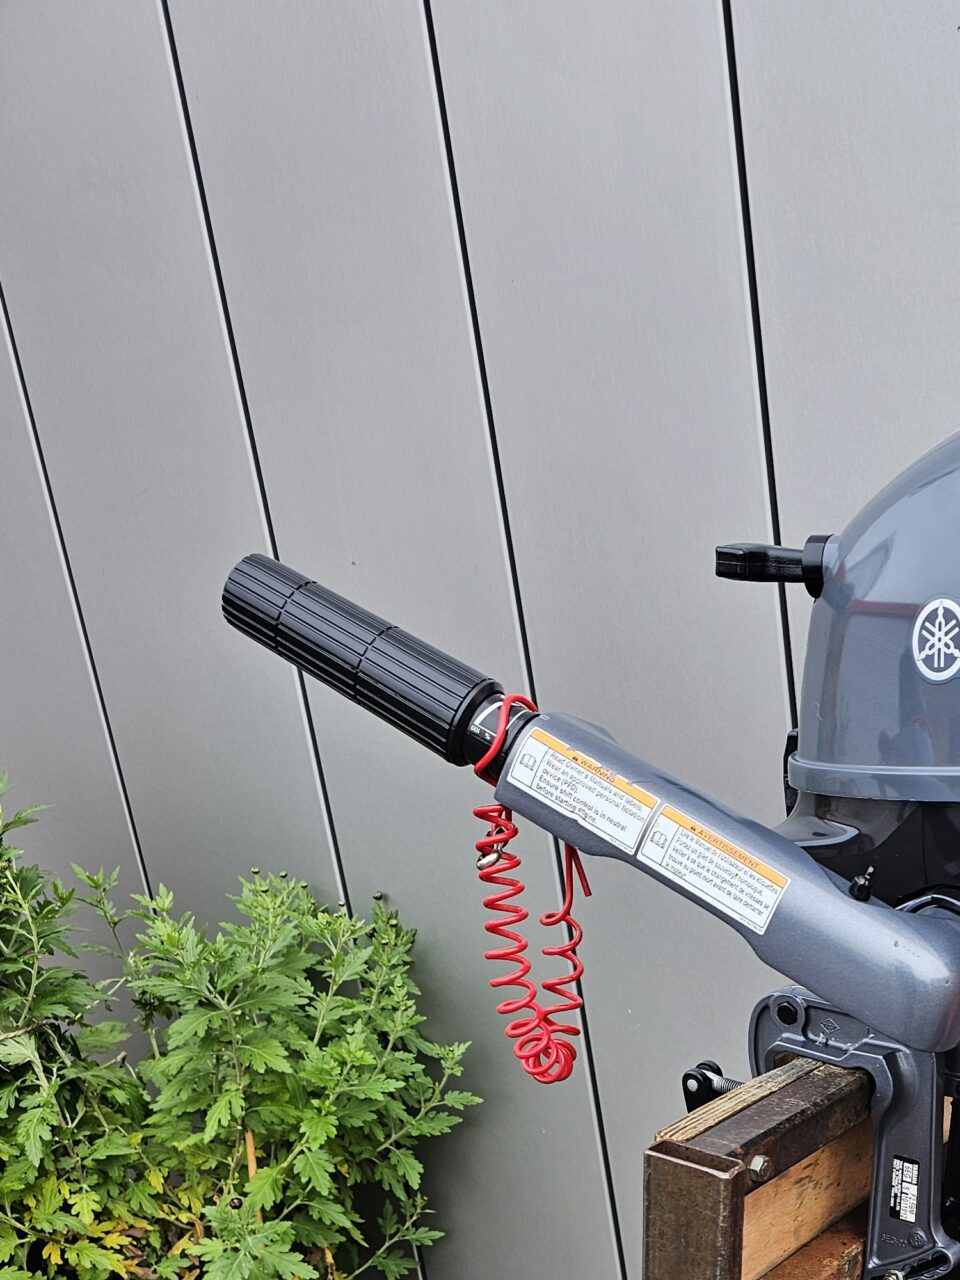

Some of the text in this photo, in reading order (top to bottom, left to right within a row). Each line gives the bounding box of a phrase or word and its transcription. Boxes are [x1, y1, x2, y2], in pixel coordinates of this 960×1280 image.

[541, 766, 562, 782] device
[545, 758, 562, 772] Wear
[560, 769, 569, 777] an
[568, 773, 596, 794] approved
[595, 790, 622, 809] personal
[579, 758, 616, 783] WARNING
[535, 782, 555, 798] before
[553, 794, 577, 812] starting
[537, 774, 627, 832] Ensure shift control is in neutral
[612, 789, 625, 800] and
[696, 828, 760, 869] AVERTISSEMENT
